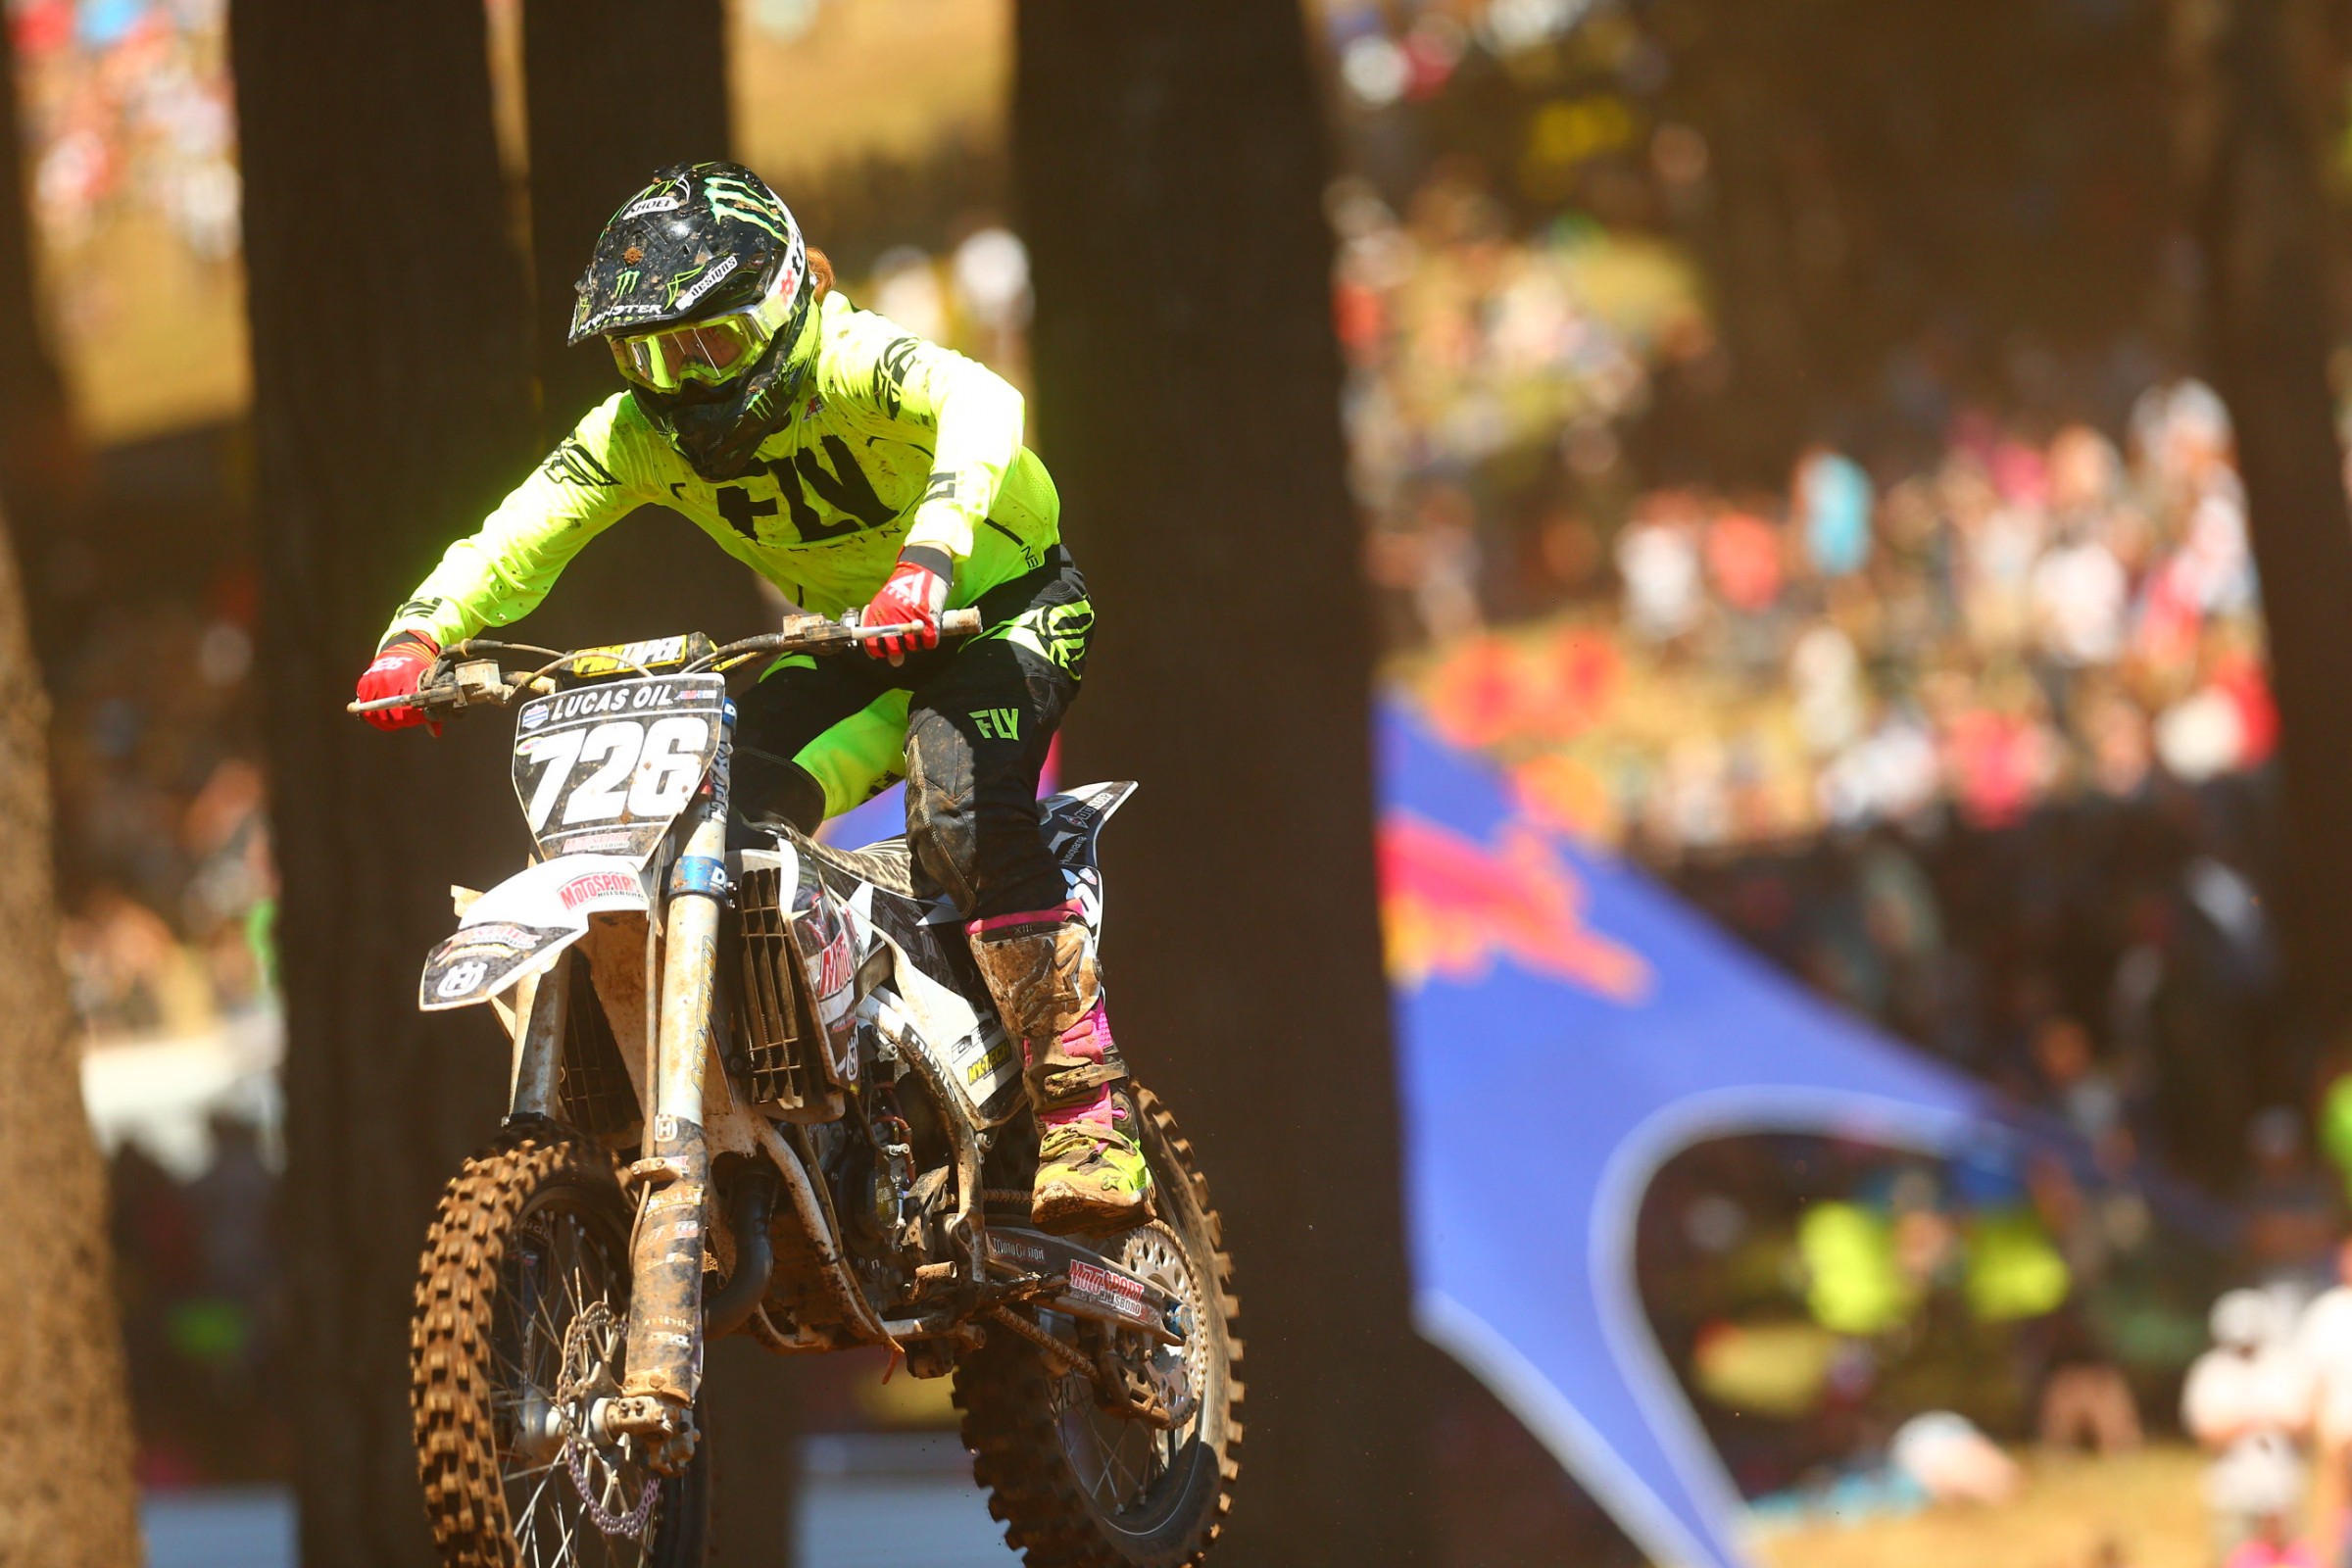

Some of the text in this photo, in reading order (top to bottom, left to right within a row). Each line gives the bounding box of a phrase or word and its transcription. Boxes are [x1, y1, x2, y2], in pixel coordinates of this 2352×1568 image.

[578, 304, 662, 334] MONSTER
[716, 434, 900, 545] FLY
[551, 684, 672, 721] LUCAS OIL
[968, 708, 1019, 741] FLY
[528, 716, 709, 835] 726
[1069, 1259, 1145, 1302] MOTOSPORT
